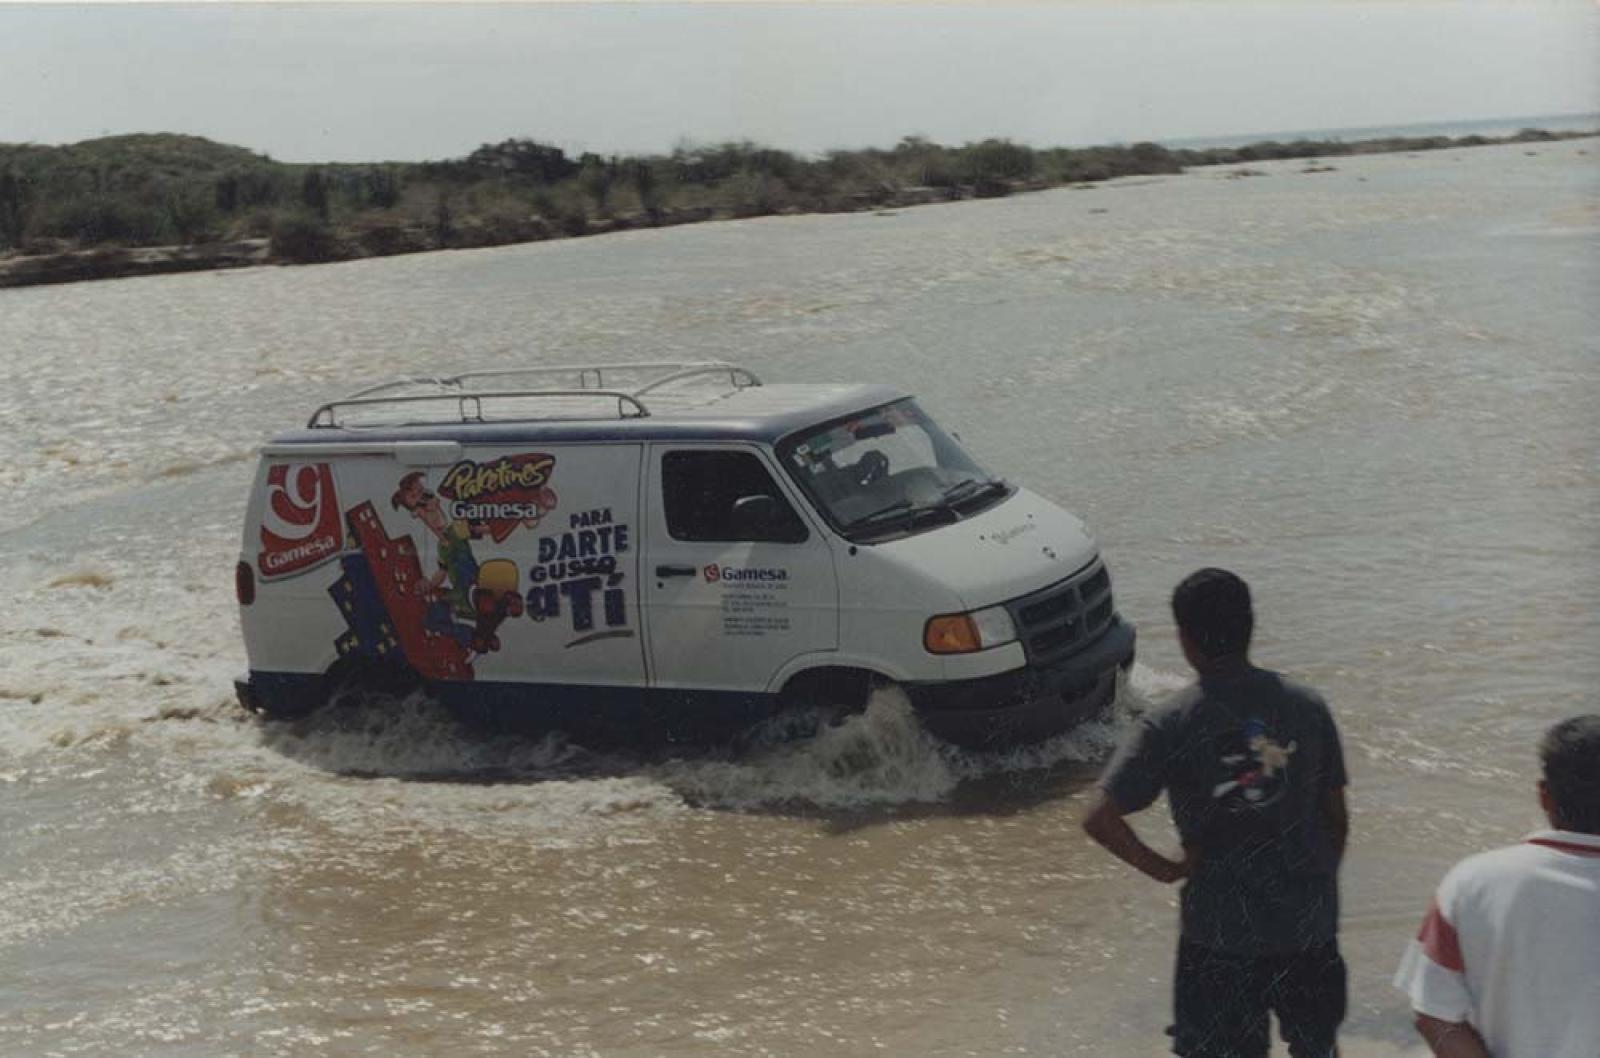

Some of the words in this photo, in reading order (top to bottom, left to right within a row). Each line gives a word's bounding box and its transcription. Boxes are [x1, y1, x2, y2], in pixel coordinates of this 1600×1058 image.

[452, 500, 537, 519] Gamesa
[570, 508, 612, 528] PARA
[266, 535, 336, 569] Gamesa
[538, 525, 628, 563] DARTE
[529, 556, 617, 582] GUSTO
[722, 567, 787, 581] Gamesa
